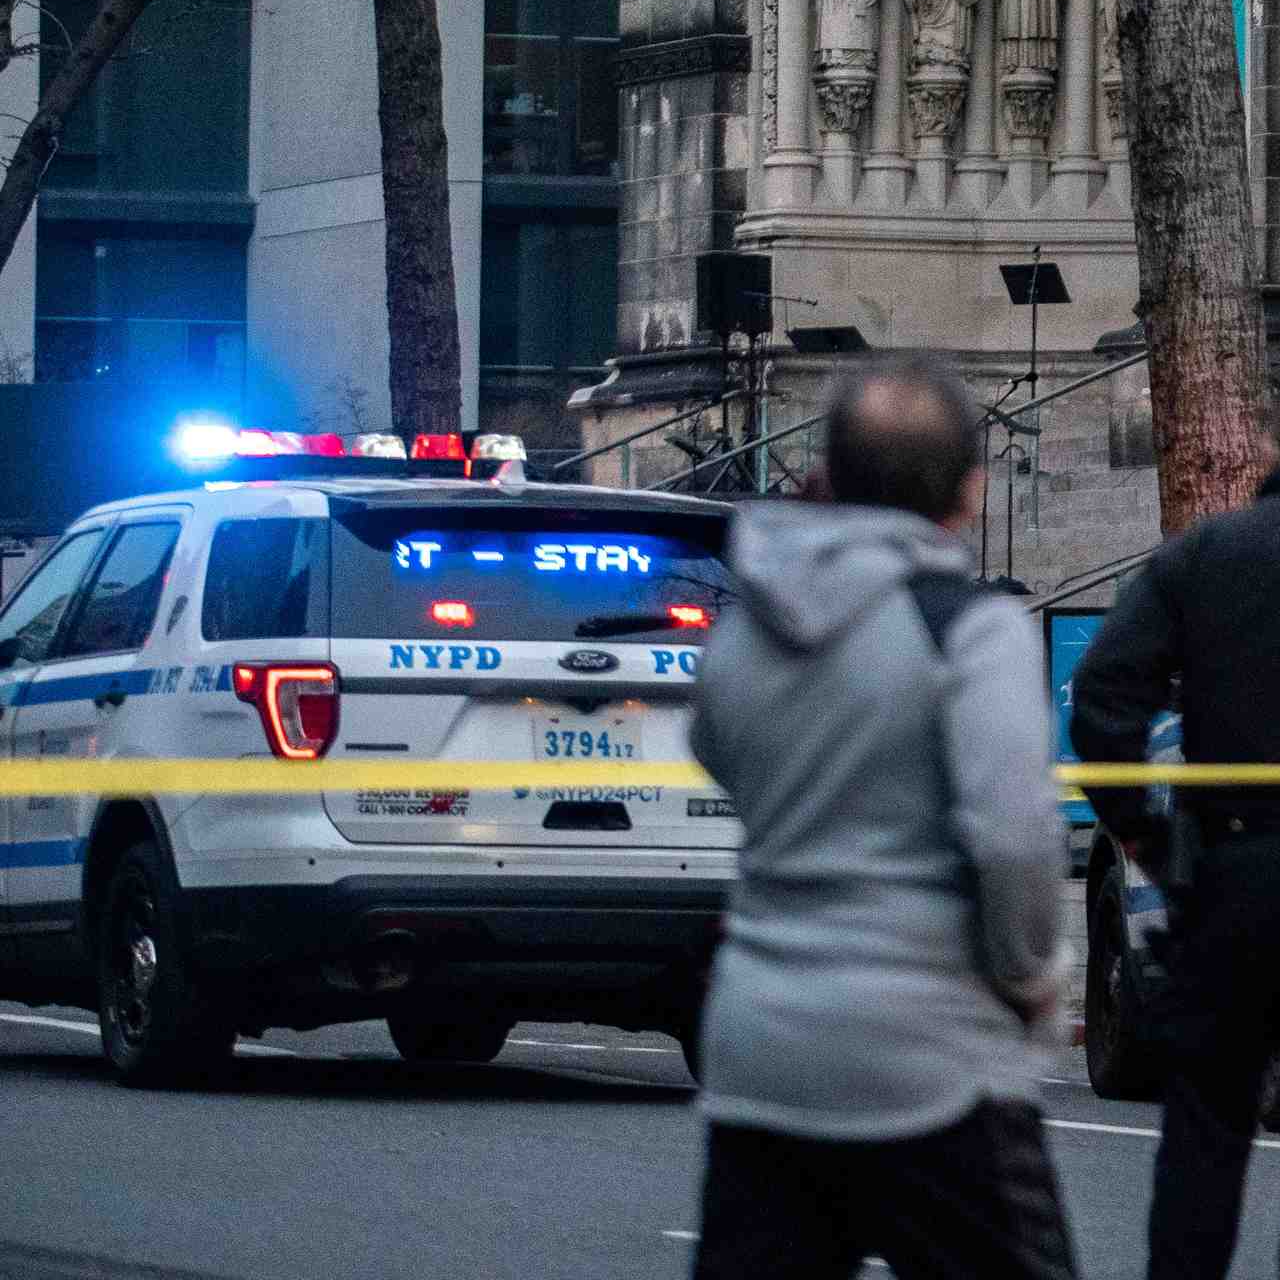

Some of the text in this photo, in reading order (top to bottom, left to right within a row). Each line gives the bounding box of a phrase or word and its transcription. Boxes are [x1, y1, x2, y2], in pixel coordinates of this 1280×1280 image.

[533, 543, 652, 573] STAY
[388, 644, 503, 672] NYPD
[544, 730, 610, 758] 3794
